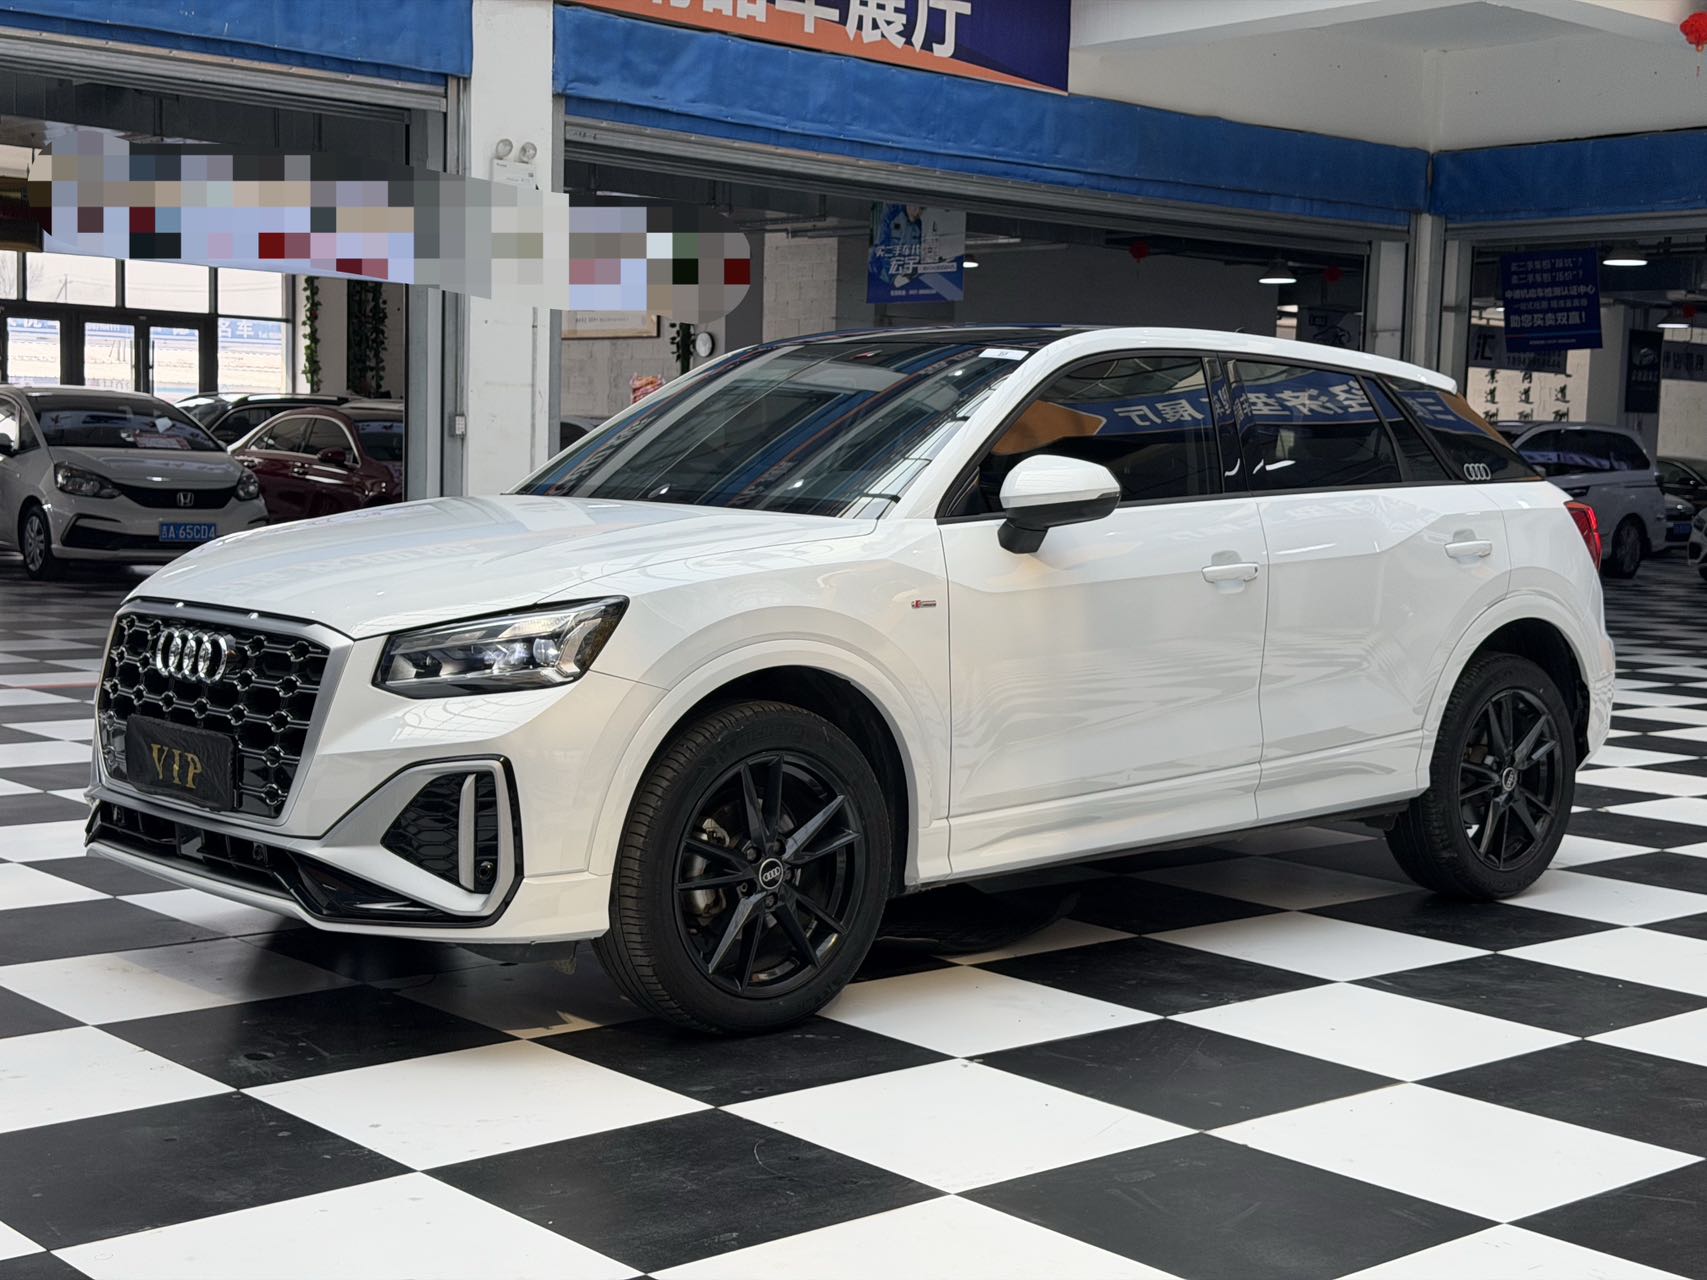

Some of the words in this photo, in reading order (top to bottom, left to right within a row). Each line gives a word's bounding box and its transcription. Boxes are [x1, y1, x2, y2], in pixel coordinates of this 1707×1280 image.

[656, 0, 972, 57] 车展厅
[151, 743, 202, 789] VIP
